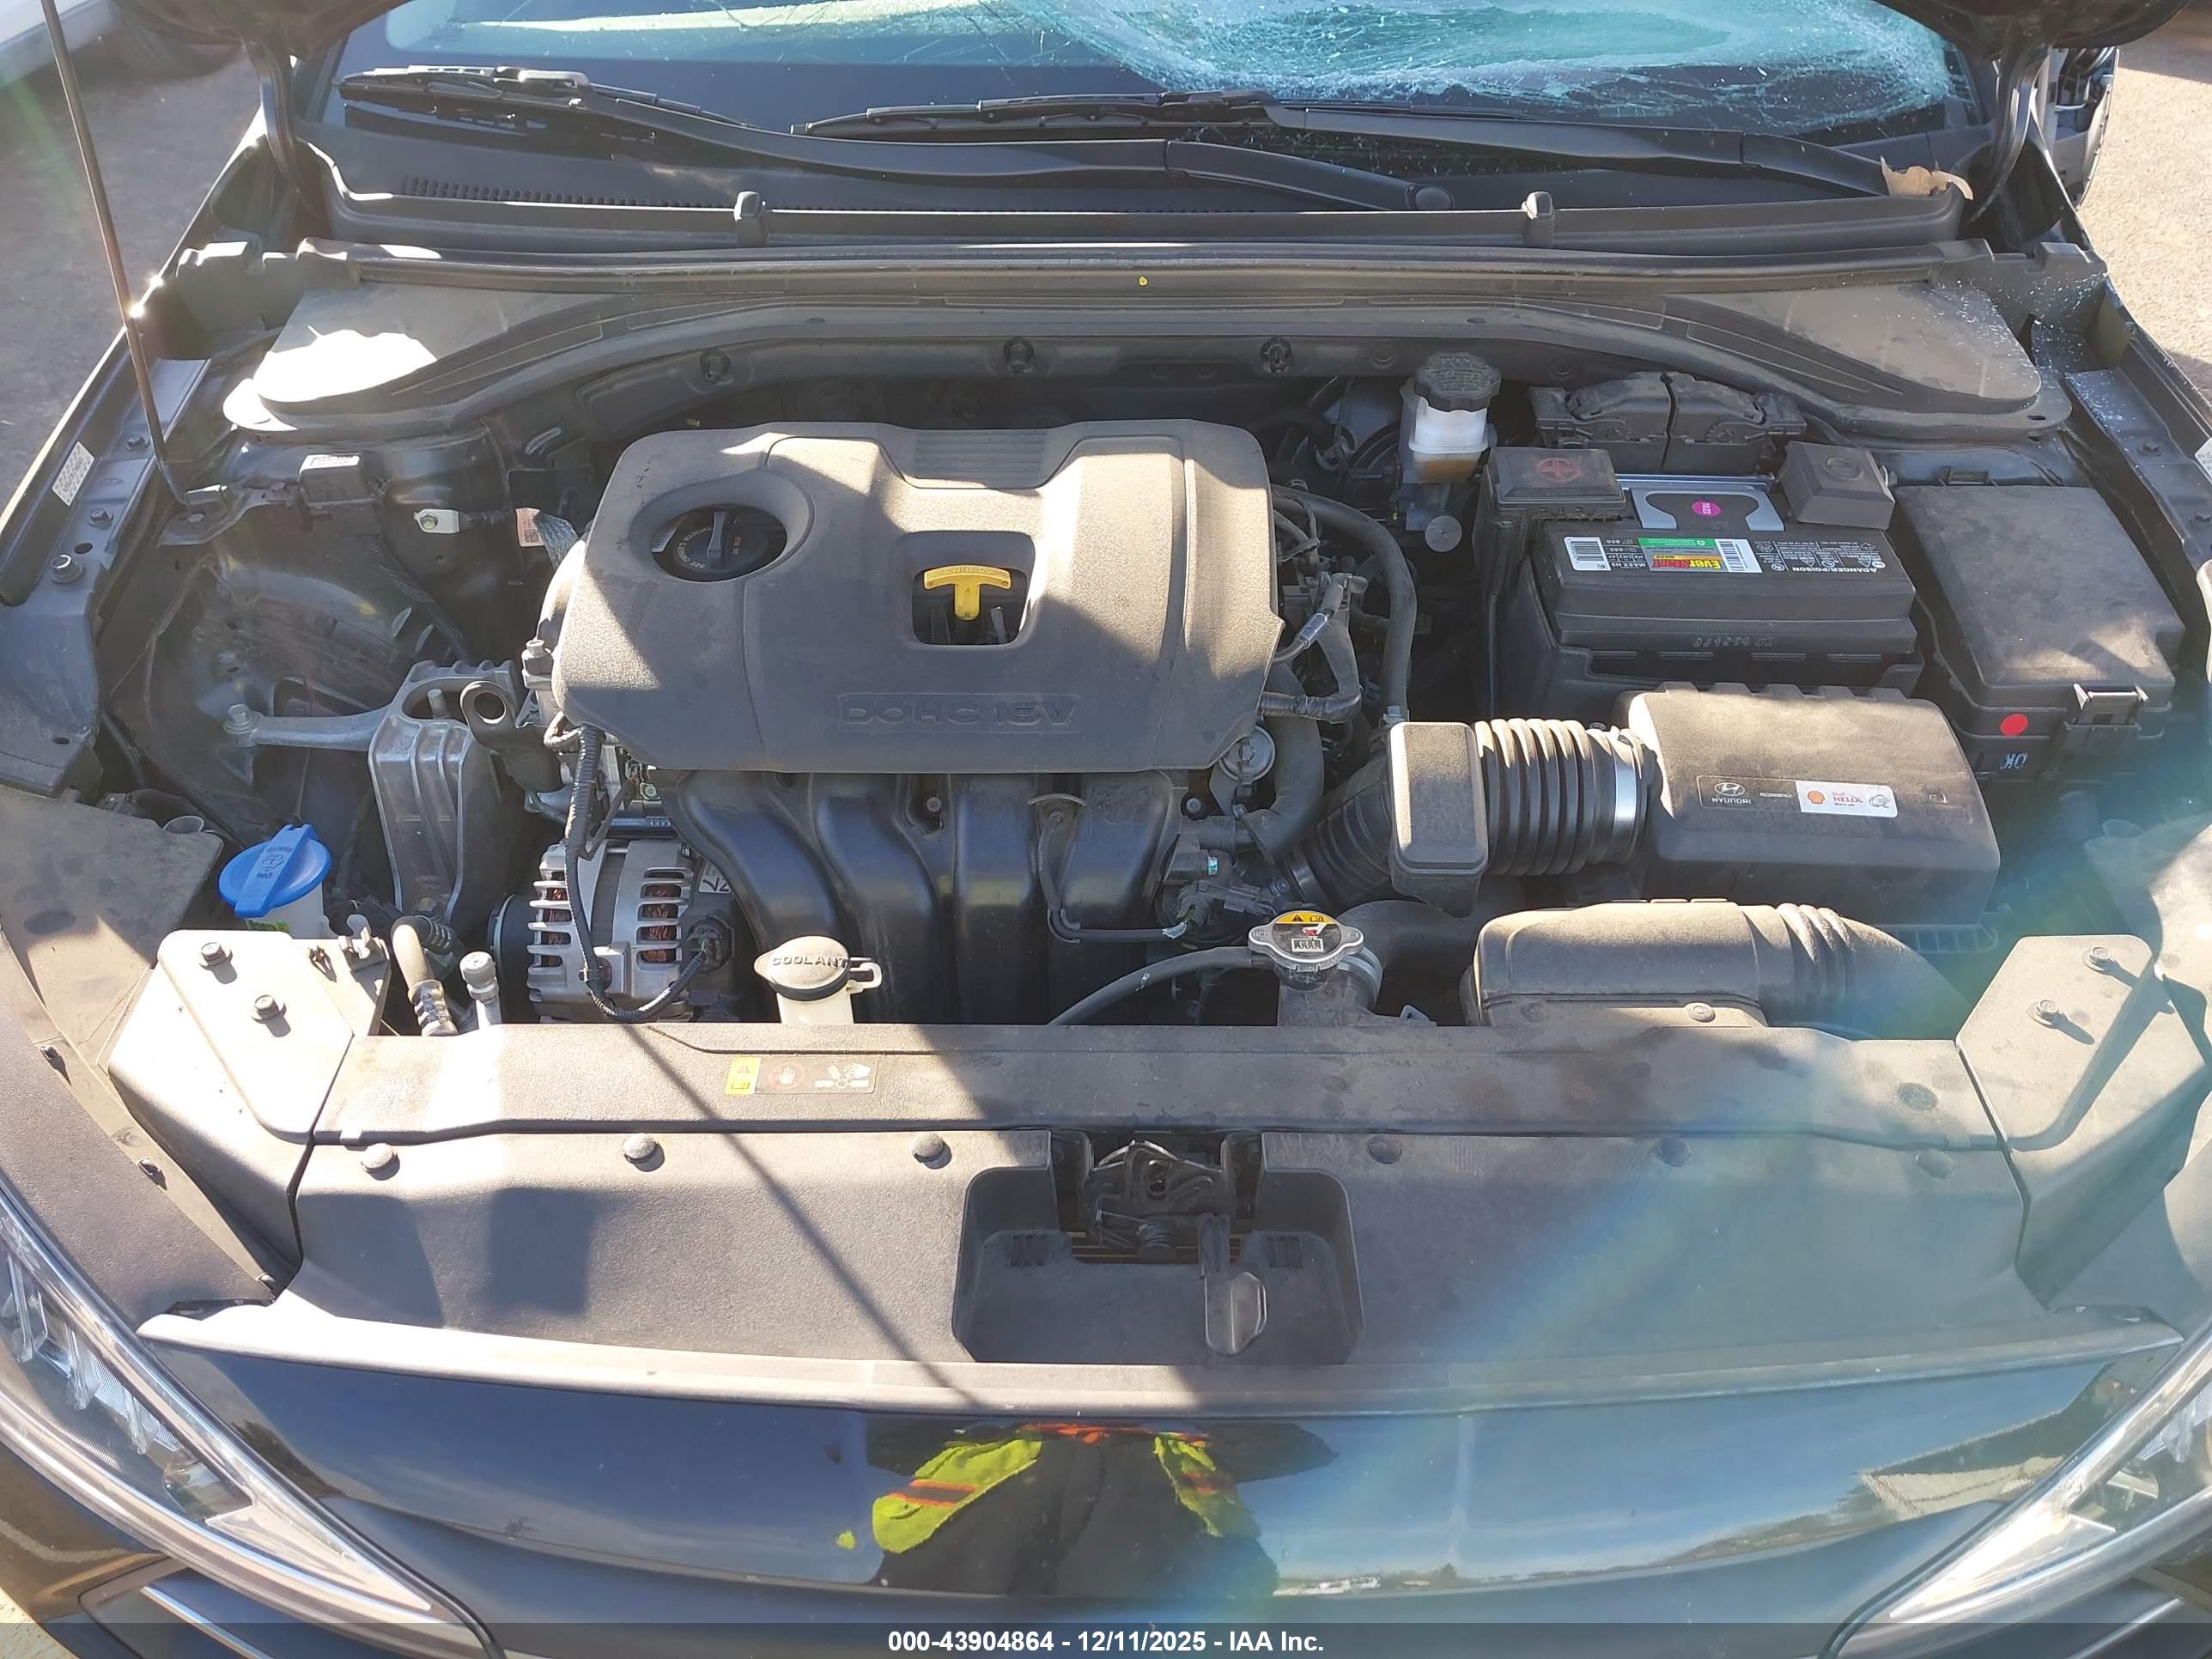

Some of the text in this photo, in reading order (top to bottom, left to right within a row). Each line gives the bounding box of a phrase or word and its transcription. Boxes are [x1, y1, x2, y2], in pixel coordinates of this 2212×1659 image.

[1652, 559, 1721, 570] EverStart
[842, 701, 1078, 726] DOHC 16V
[772, 955, 848, 969] COOLANT
